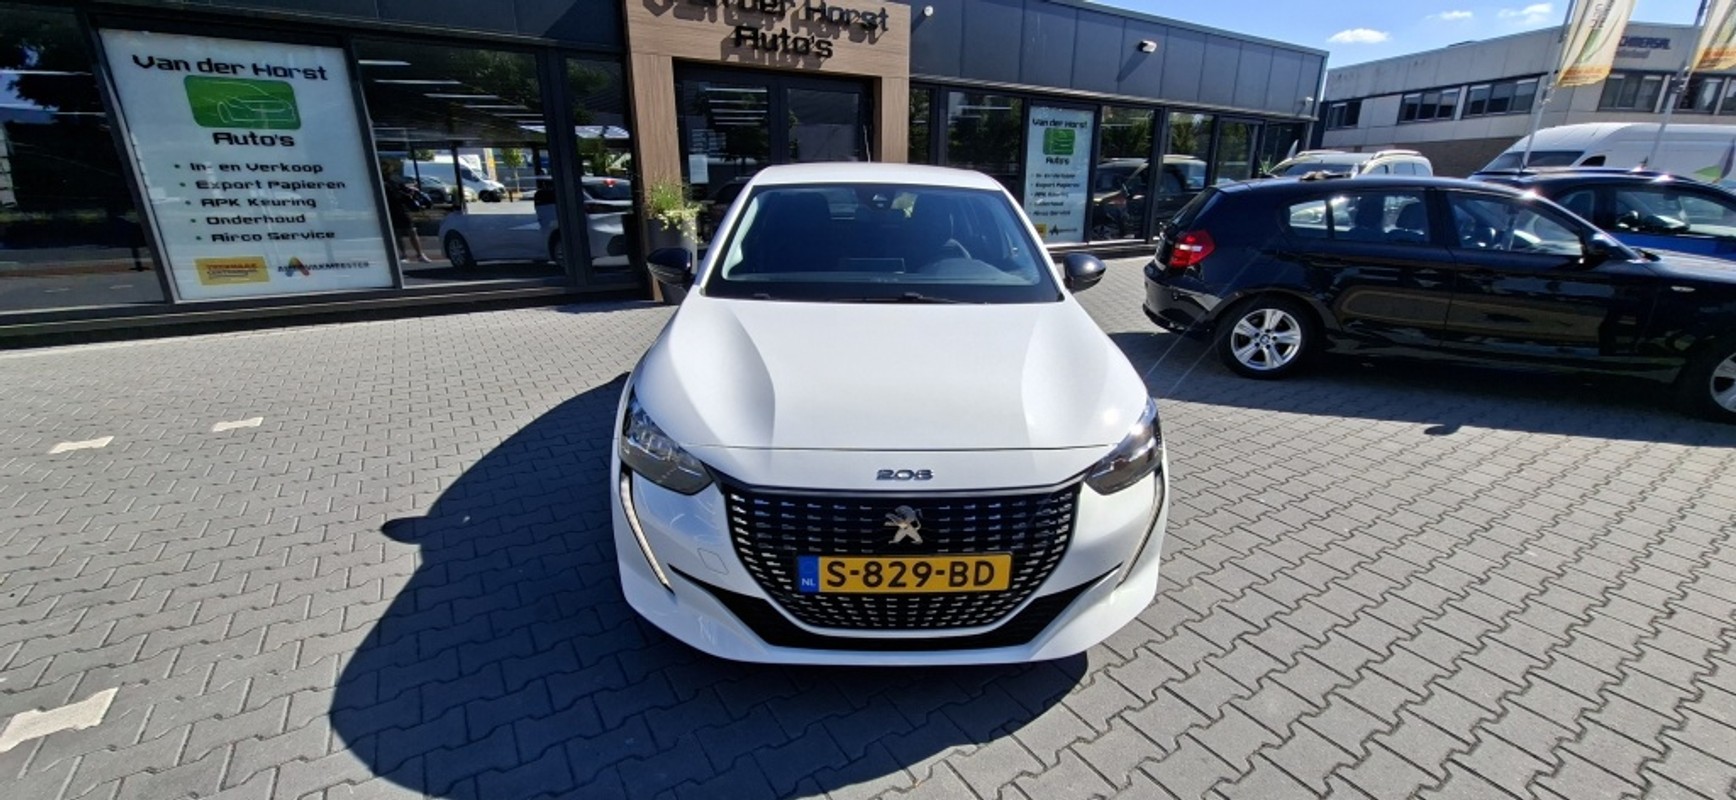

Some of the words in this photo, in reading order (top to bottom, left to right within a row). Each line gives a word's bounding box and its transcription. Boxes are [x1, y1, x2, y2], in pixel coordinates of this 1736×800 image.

[806, 0, 888, 32] Horst
[734, 25, 833, 59] Auto's
[132, 54, 191, 72] Van
[197, 58, 245, 75] der
[252, 62, 328, 81] Horst
[212, 131, 295, 147] Auto's
[219, 164, 241, 172] en
[246, 162, 323, 174] Verkoop
[195, 180, 262, 191] Export
[267, 179, 346, 190] Papieren
[201, 198, 241, 208] APK
[247, 198, 317, 208] Keuring
[206, 214, 306, 225] Onderhoud
[211, 232, 262, 242] Airco
[267, 230, 335, 241] Service
[826, 561, 995, 588] S-829-BD
[801, 578, 816, 587] NL
